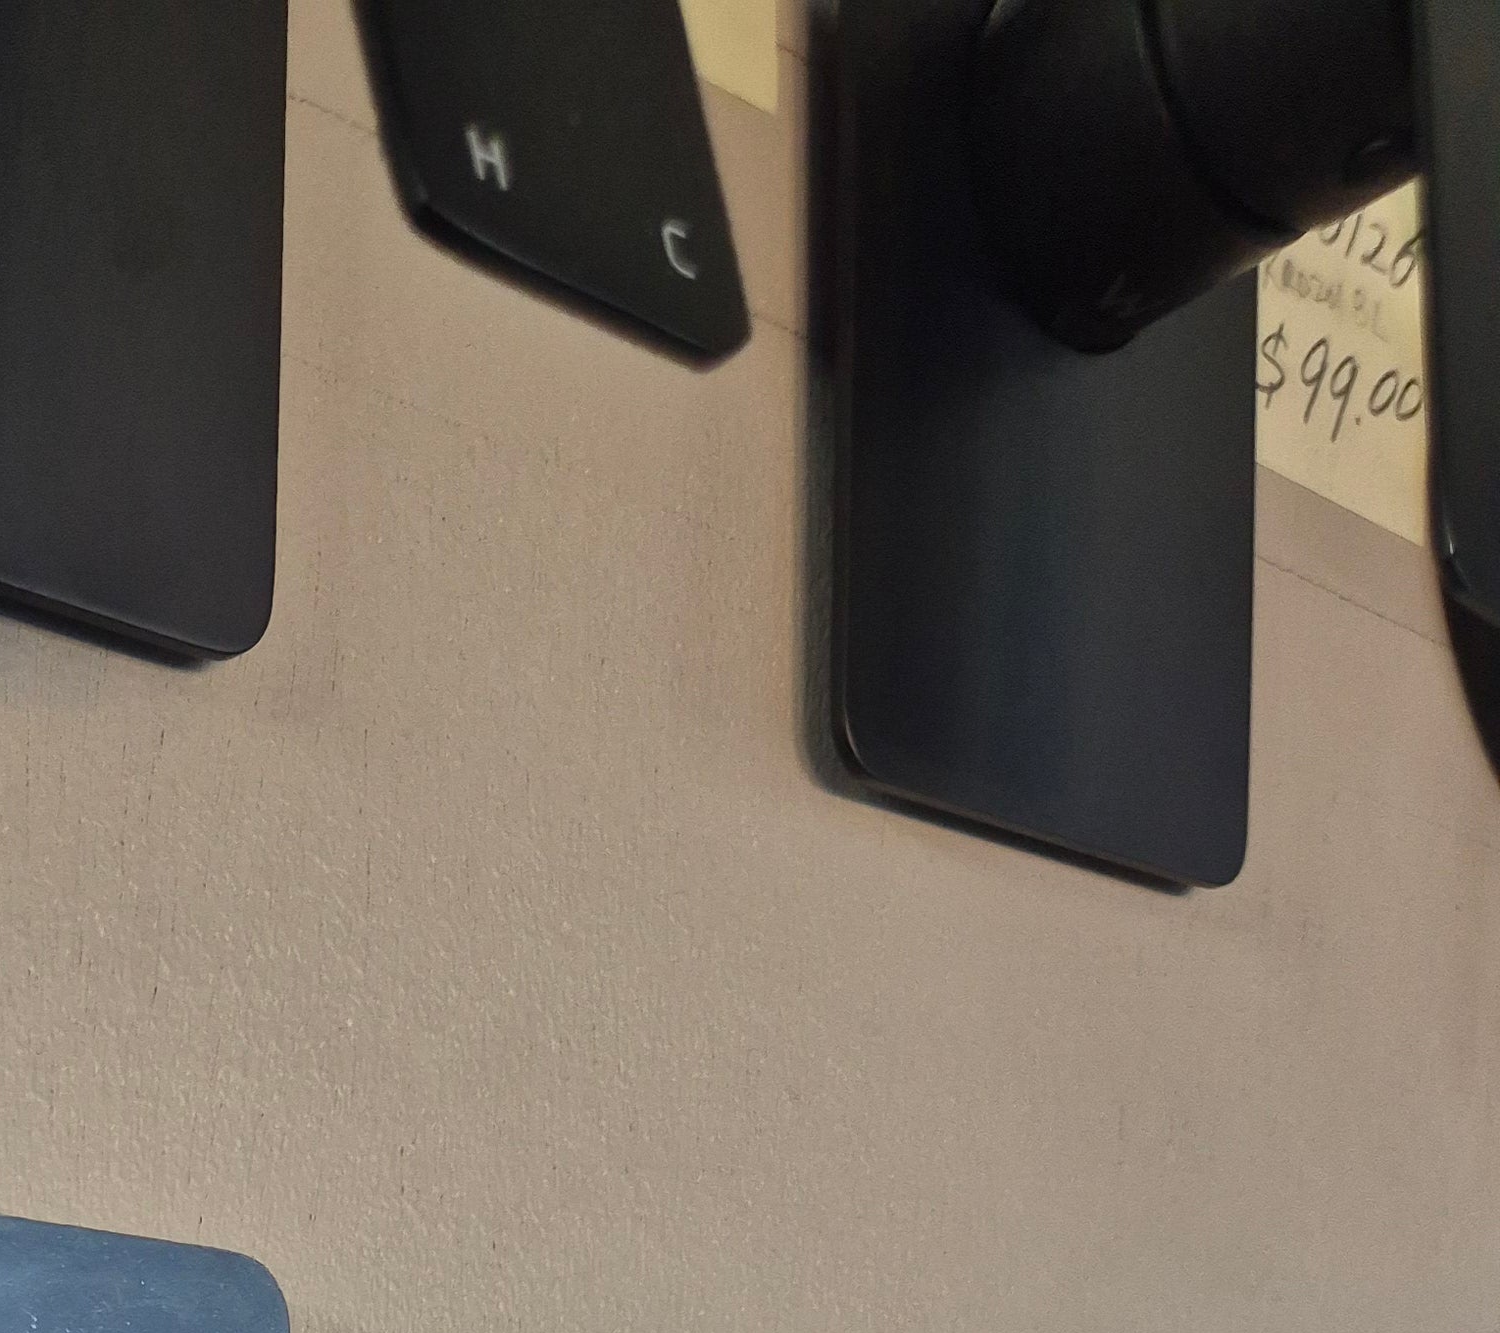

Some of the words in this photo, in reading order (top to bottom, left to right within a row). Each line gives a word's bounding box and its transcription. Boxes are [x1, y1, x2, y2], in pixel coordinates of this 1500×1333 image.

[466, 122, 511, 192] H
[660, 217, 697, 281] C
[1255, 323, 1424, 442] $99.00
